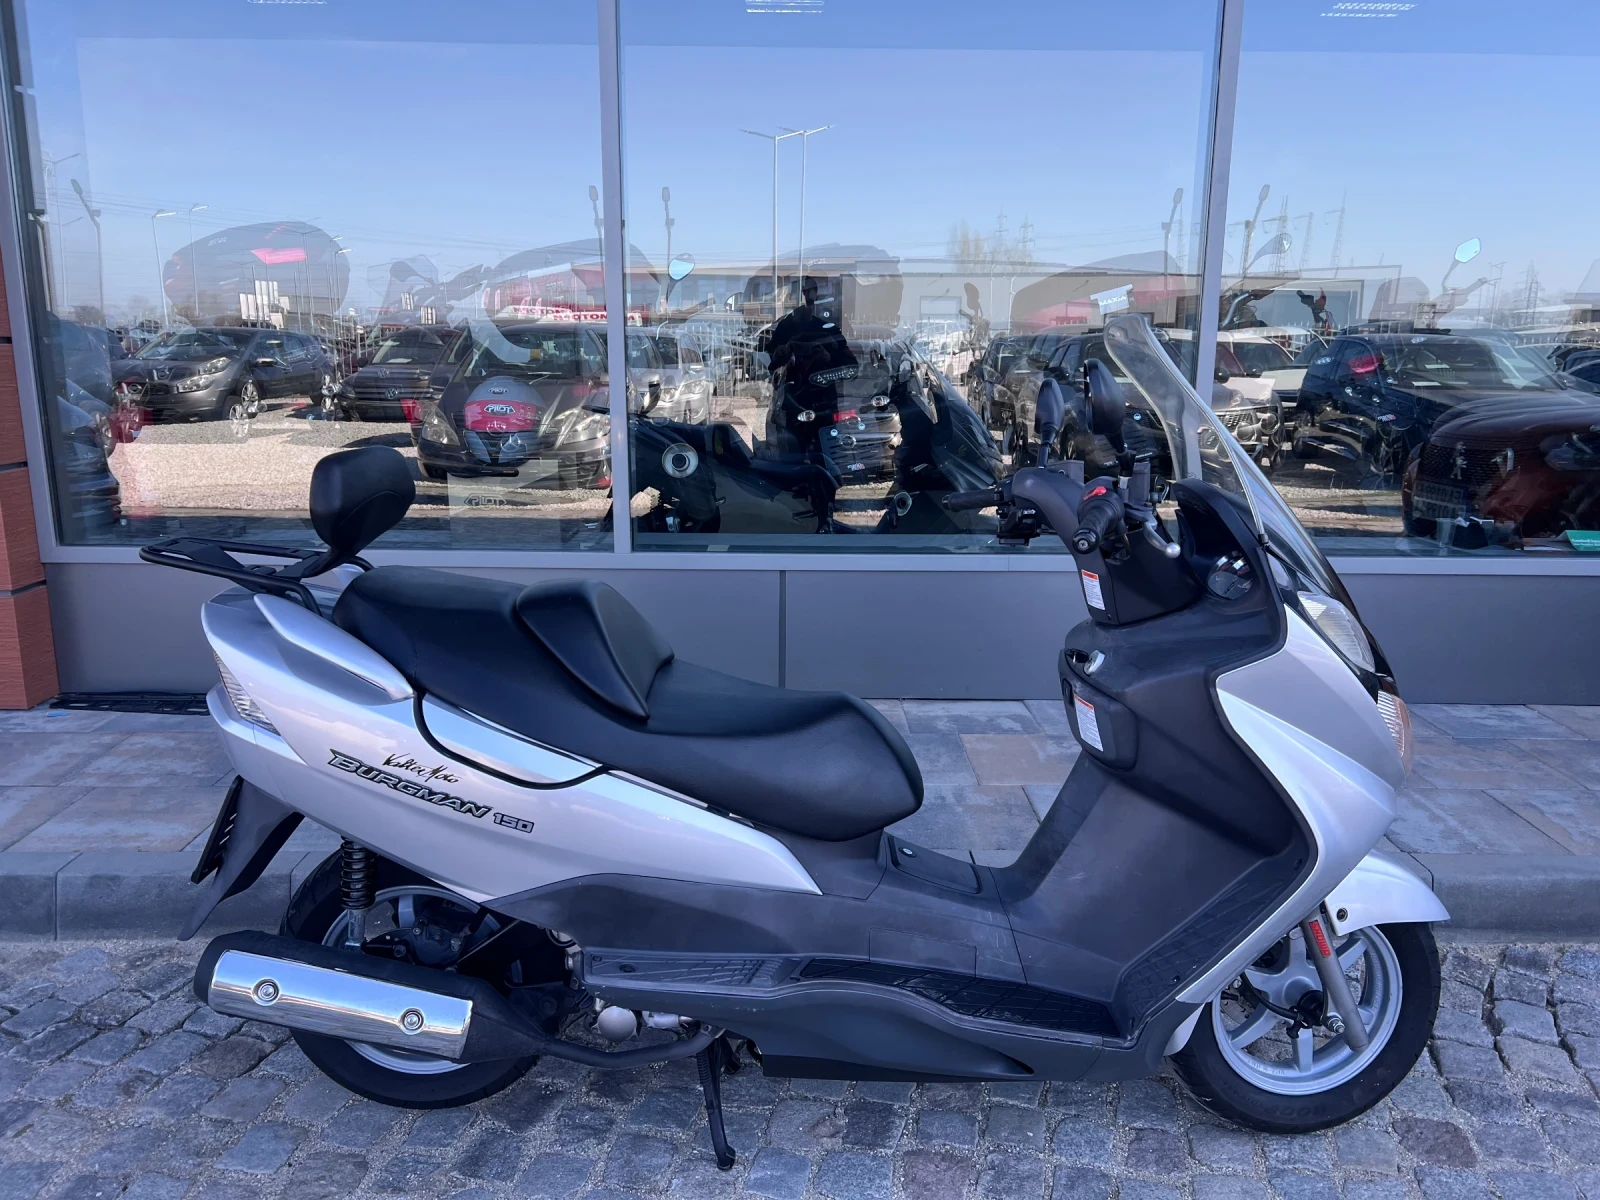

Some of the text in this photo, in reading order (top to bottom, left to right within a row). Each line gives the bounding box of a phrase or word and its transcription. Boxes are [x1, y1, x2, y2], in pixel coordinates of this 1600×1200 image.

[486, 404, 514, 414] PILOT
[469, 494, 503, 506] PILOT
[424, 764, 460, 783] Moto
[327, 748, 535, 833] BURGMAN 150
[1309, 920, 1331, 957] SHOWA
